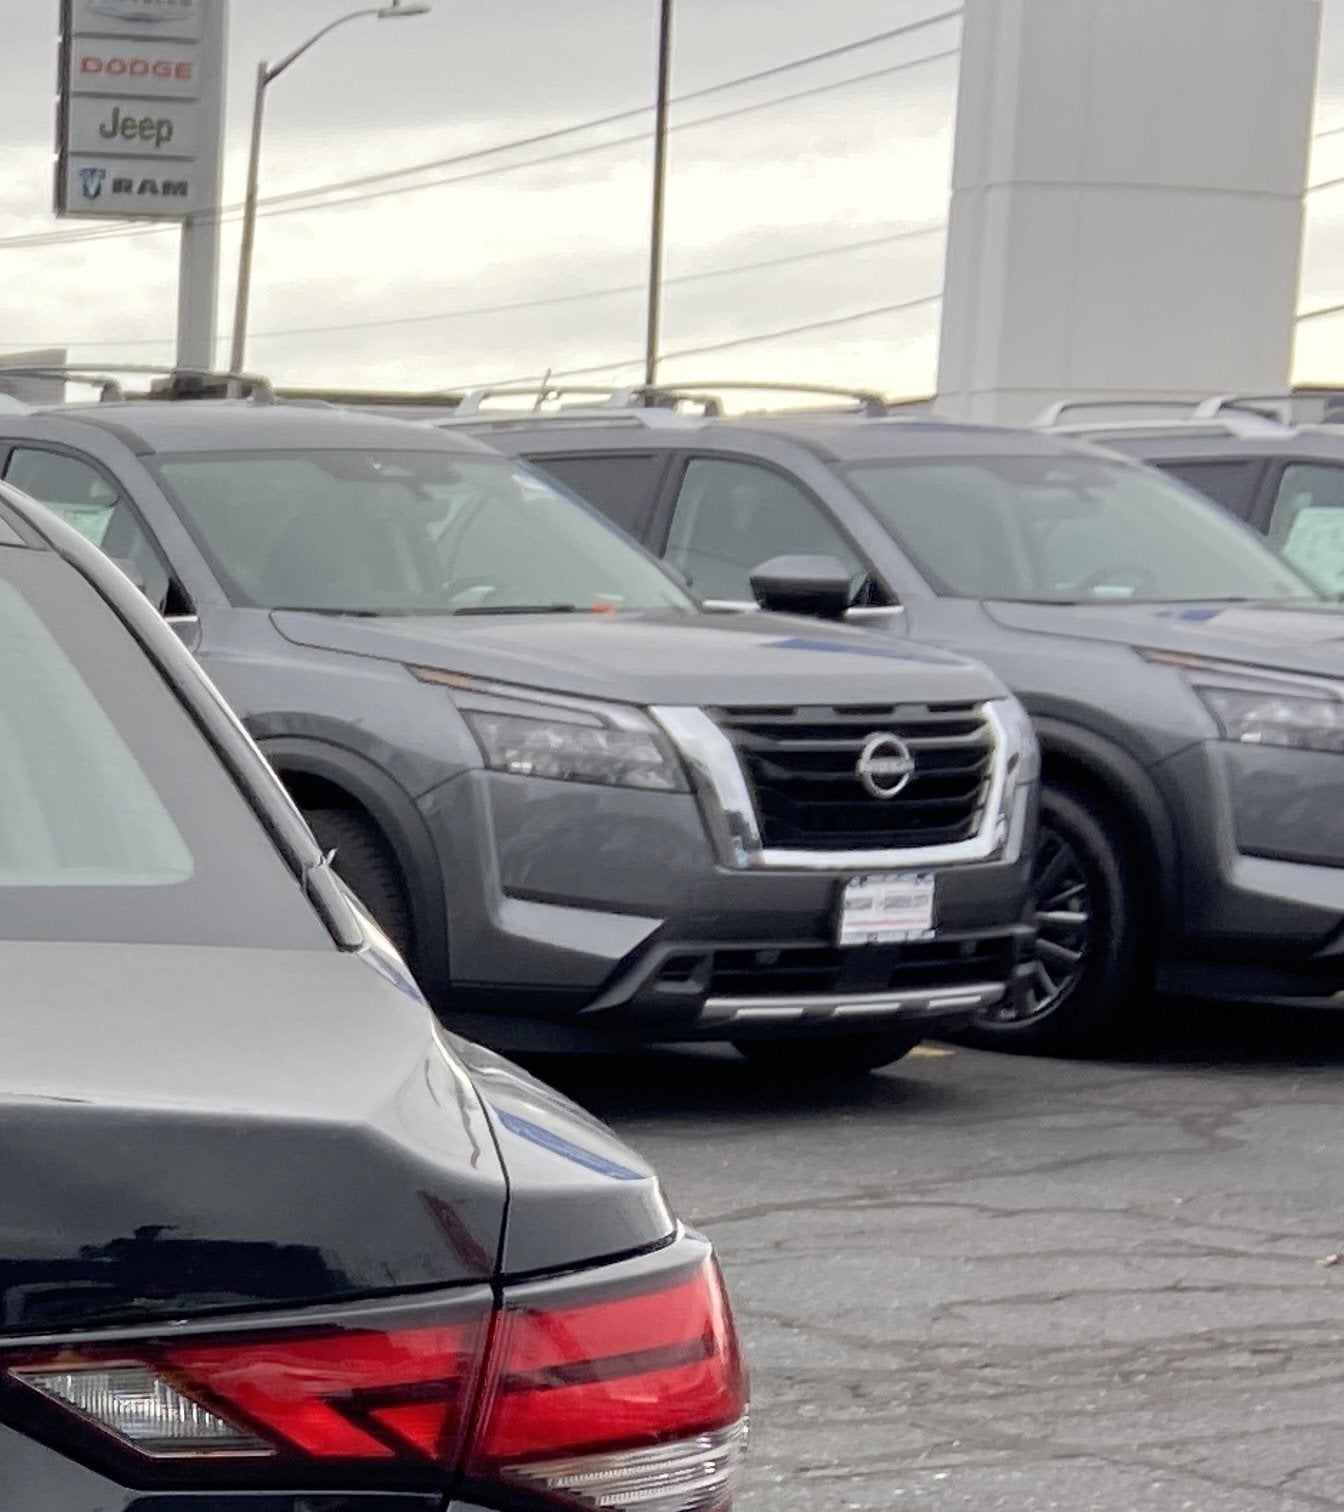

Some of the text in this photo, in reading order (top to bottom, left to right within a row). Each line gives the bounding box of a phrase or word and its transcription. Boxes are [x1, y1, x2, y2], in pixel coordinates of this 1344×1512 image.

[80, 57, 192, 79] DODGE
[99, 106, 174, 147] Jeep
[113, 177, 188, 196] RAM
